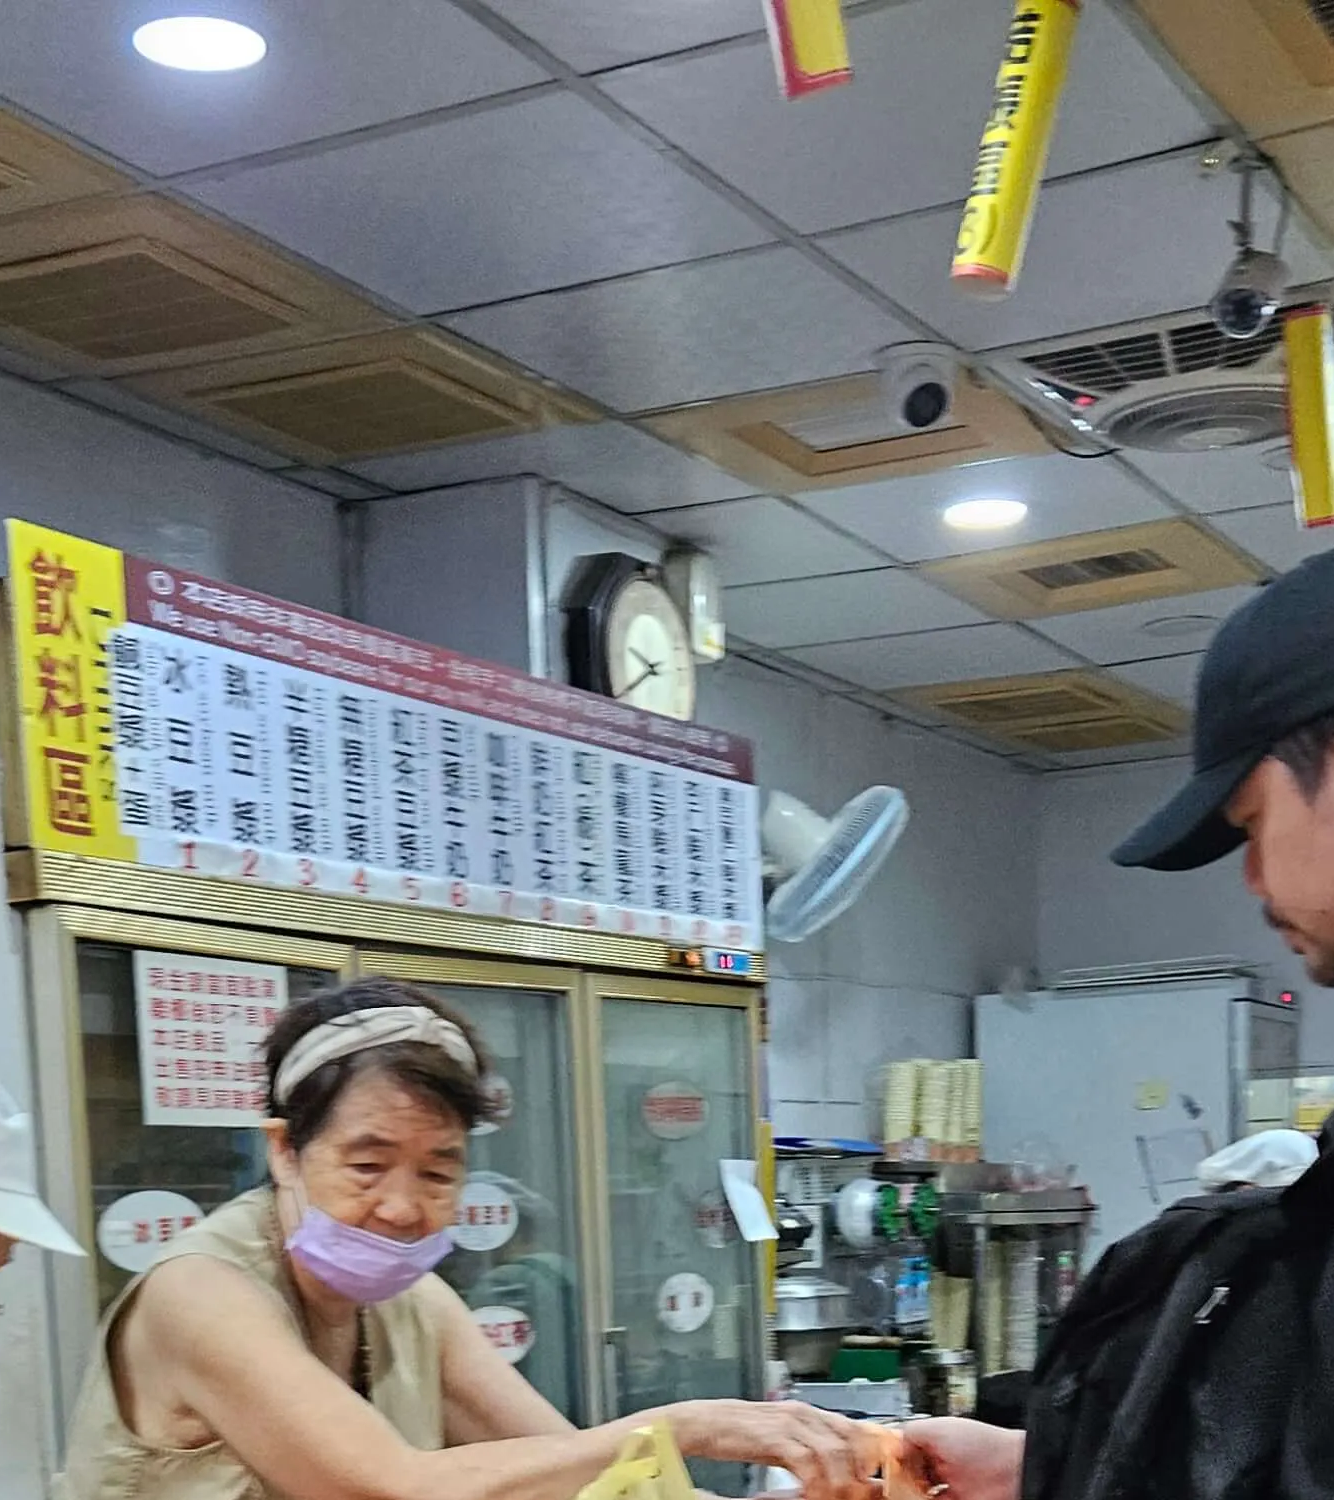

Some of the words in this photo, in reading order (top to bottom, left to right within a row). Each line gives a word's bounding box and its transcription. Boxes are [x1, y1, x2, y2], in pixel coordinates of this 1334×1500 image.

[26, 548, 97, 838] 飲料區
[177, 840, 198, 870] 1
[241, 848, 260, 878] 2
[297, 857, 315, 887] 3
[351, 866, 370, 895] 4
[400, 876, 422, 902] 5
